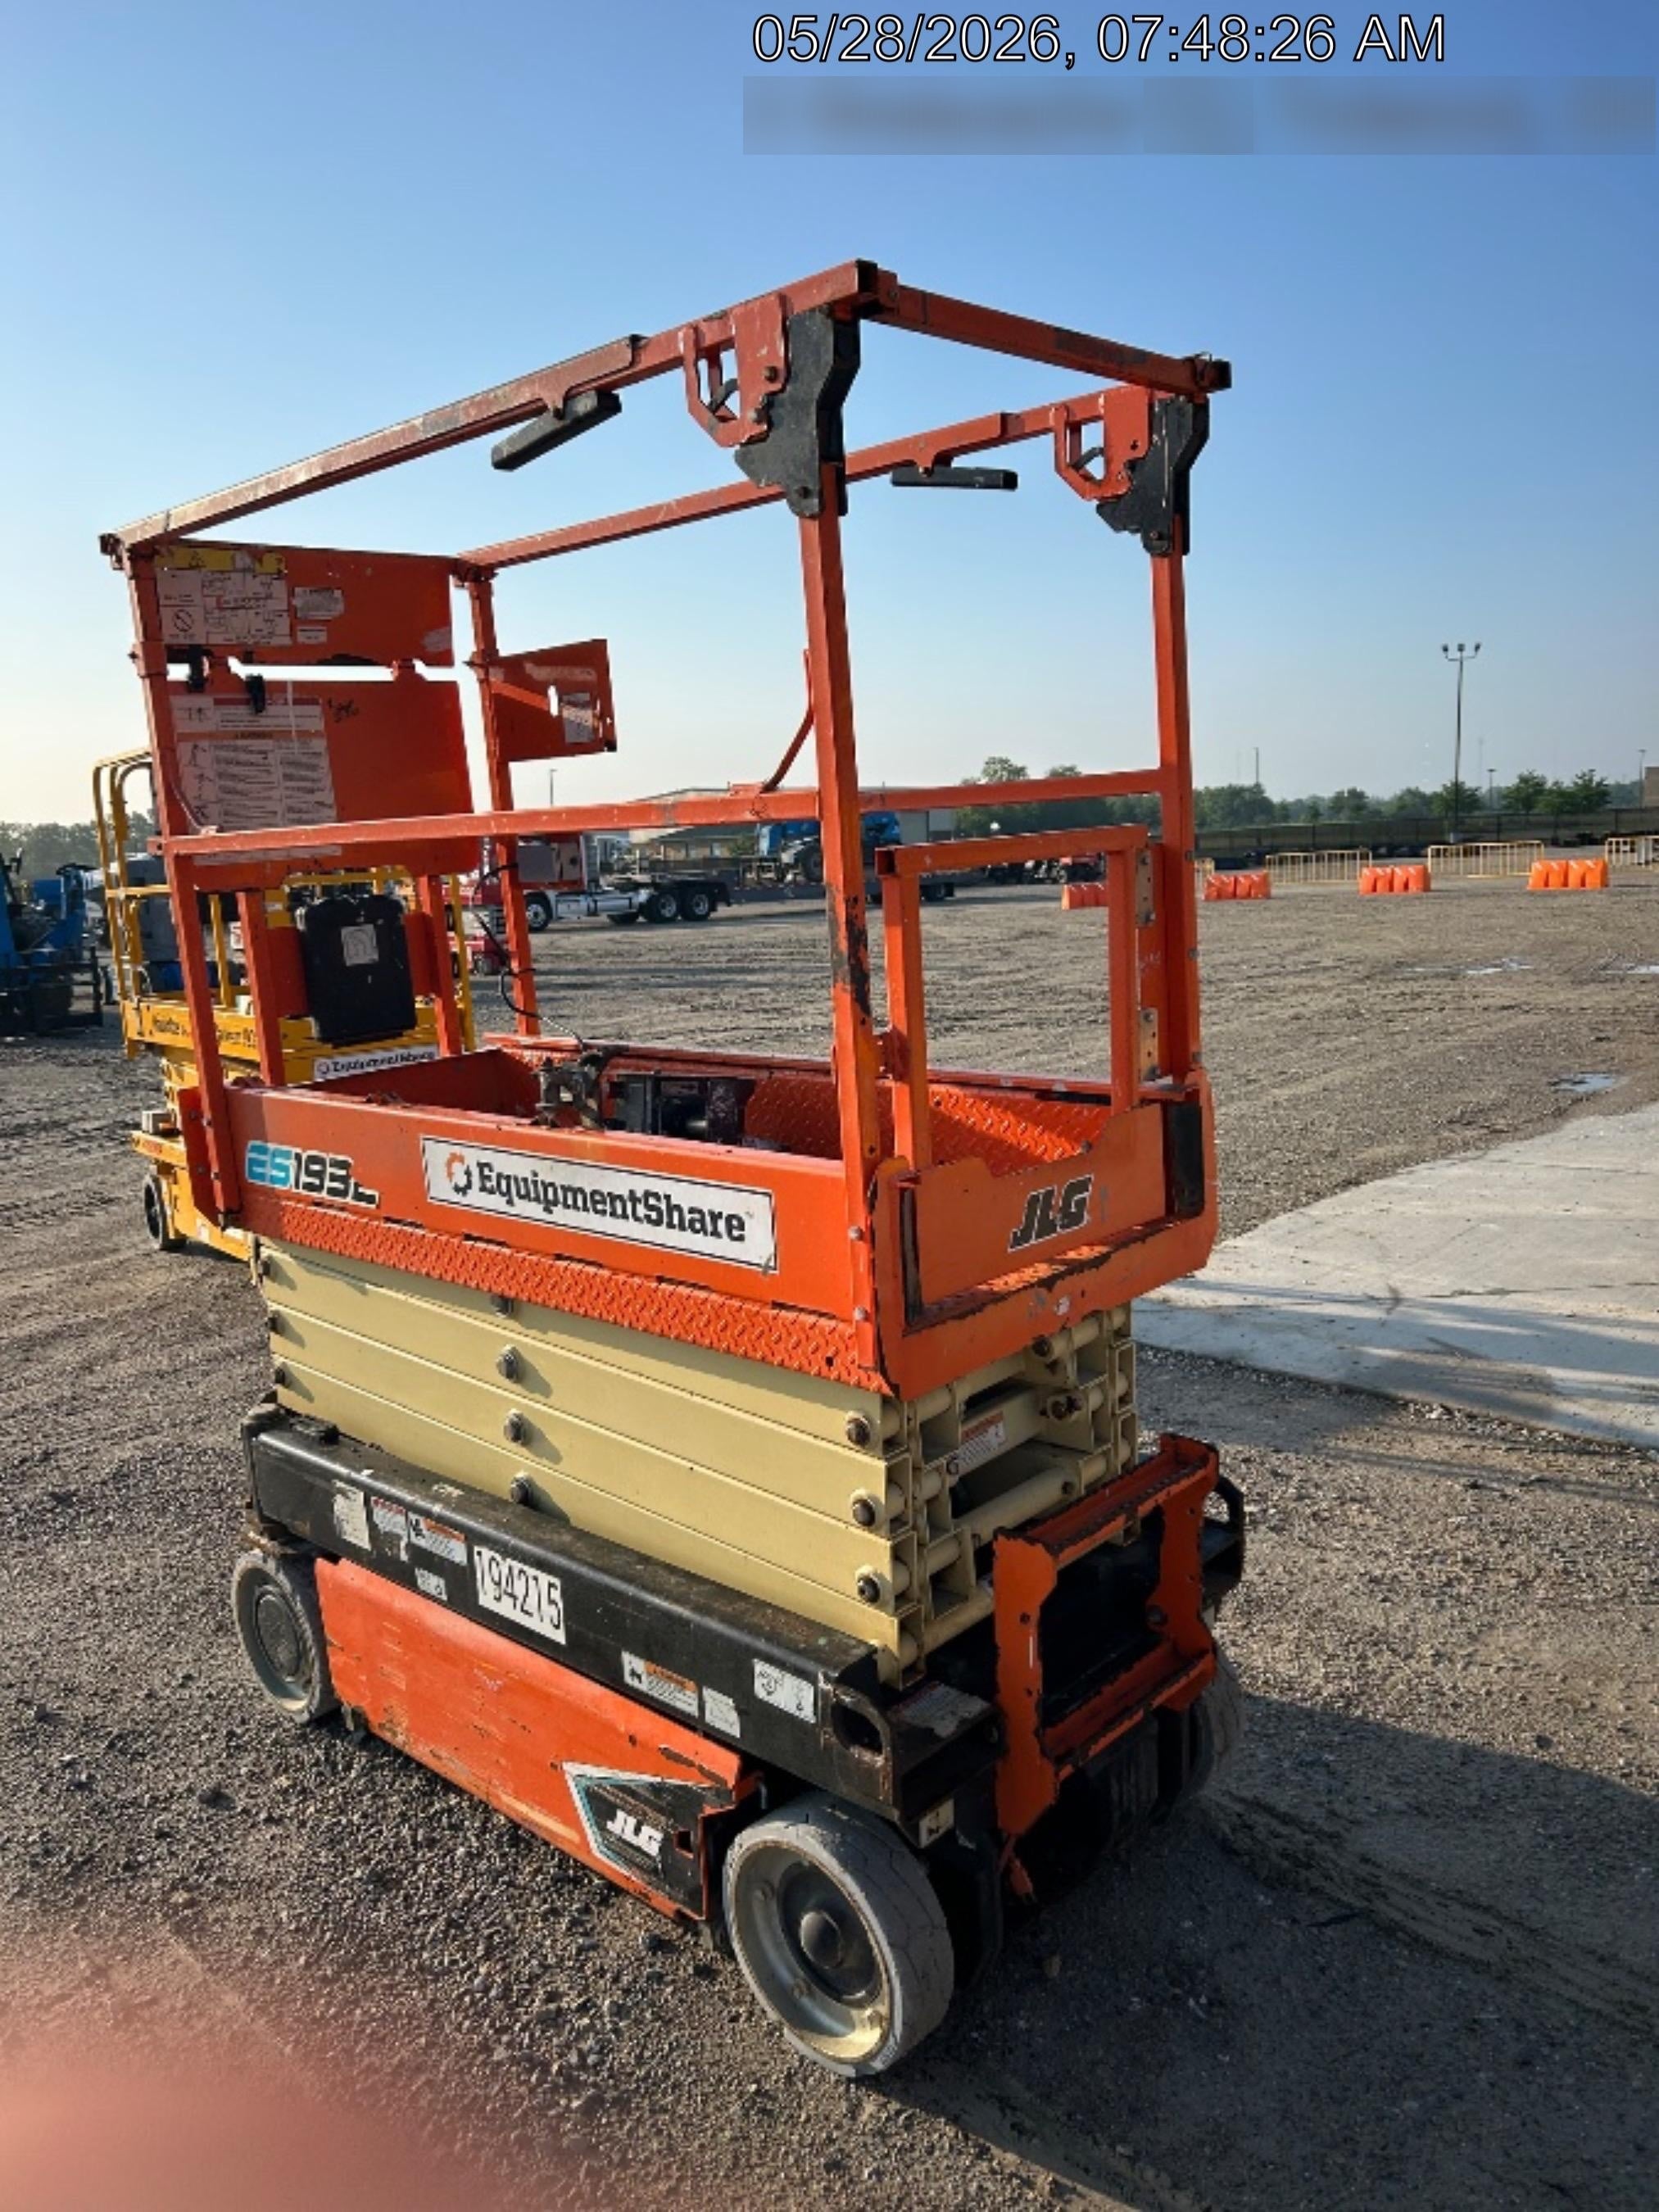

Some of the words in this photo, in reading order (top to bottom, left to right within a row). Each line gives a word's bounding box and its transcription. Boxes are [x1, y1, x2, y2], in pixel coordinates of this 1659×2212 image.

[476, 1160, 747, 1242] EquipmentShare
[1008, 1174, 1095, 1253] JLG
[606, 1808, 664, 1857] JLG
